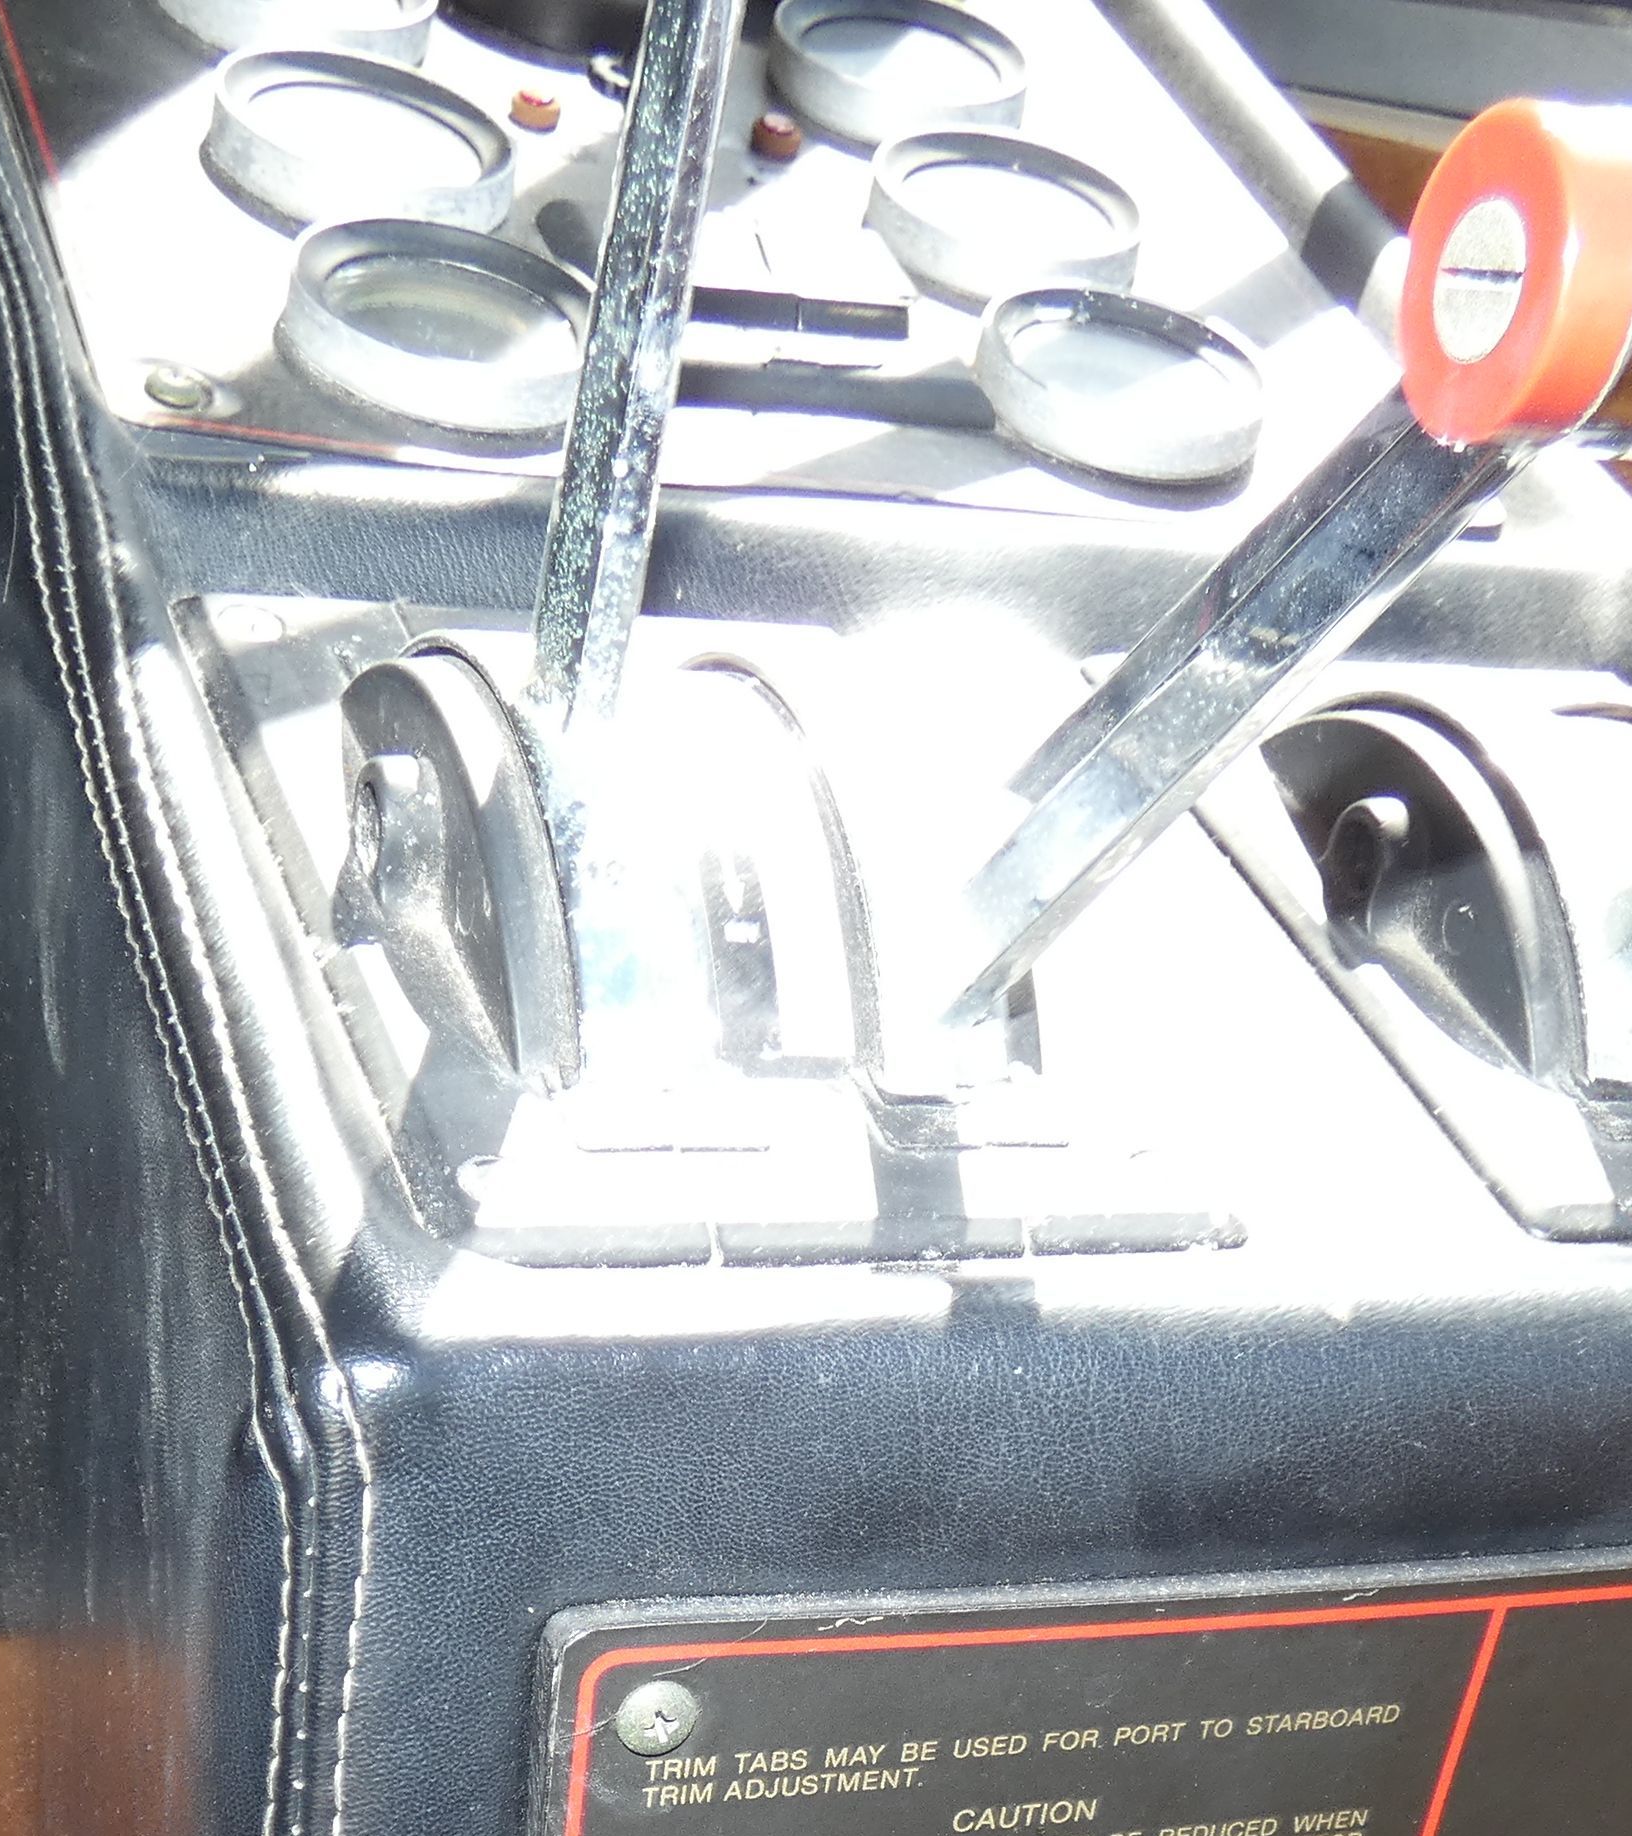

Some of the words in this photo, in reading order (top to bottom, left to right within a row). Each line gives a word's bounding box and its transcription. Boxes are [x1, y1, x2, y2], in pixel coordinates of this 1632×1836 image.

[645, 1755, 717, 1782] TRIM
[734, 1749, 809, 1774] TABS
[825, 1743, 886, 1767] MAY
[900, 1741, 938, 1763] BE
[953, 1734, 1027, 1759] USED
[1043, 1729, 1099, 1752] FOR
[1114, 1722, 1186, 1747] PORT
[1200, 1718, 1233, 1741] TO
[1246, 1704, 1401, 1736] STARBOARD
[643, 1782, 713, 1808] TRIM
[723, 1767, 924, 1802] ADJUSTMENT.
[953, 1799, 1098, 1833] CAUTION
[1294, 1809, 1369, 1833] WHEN
